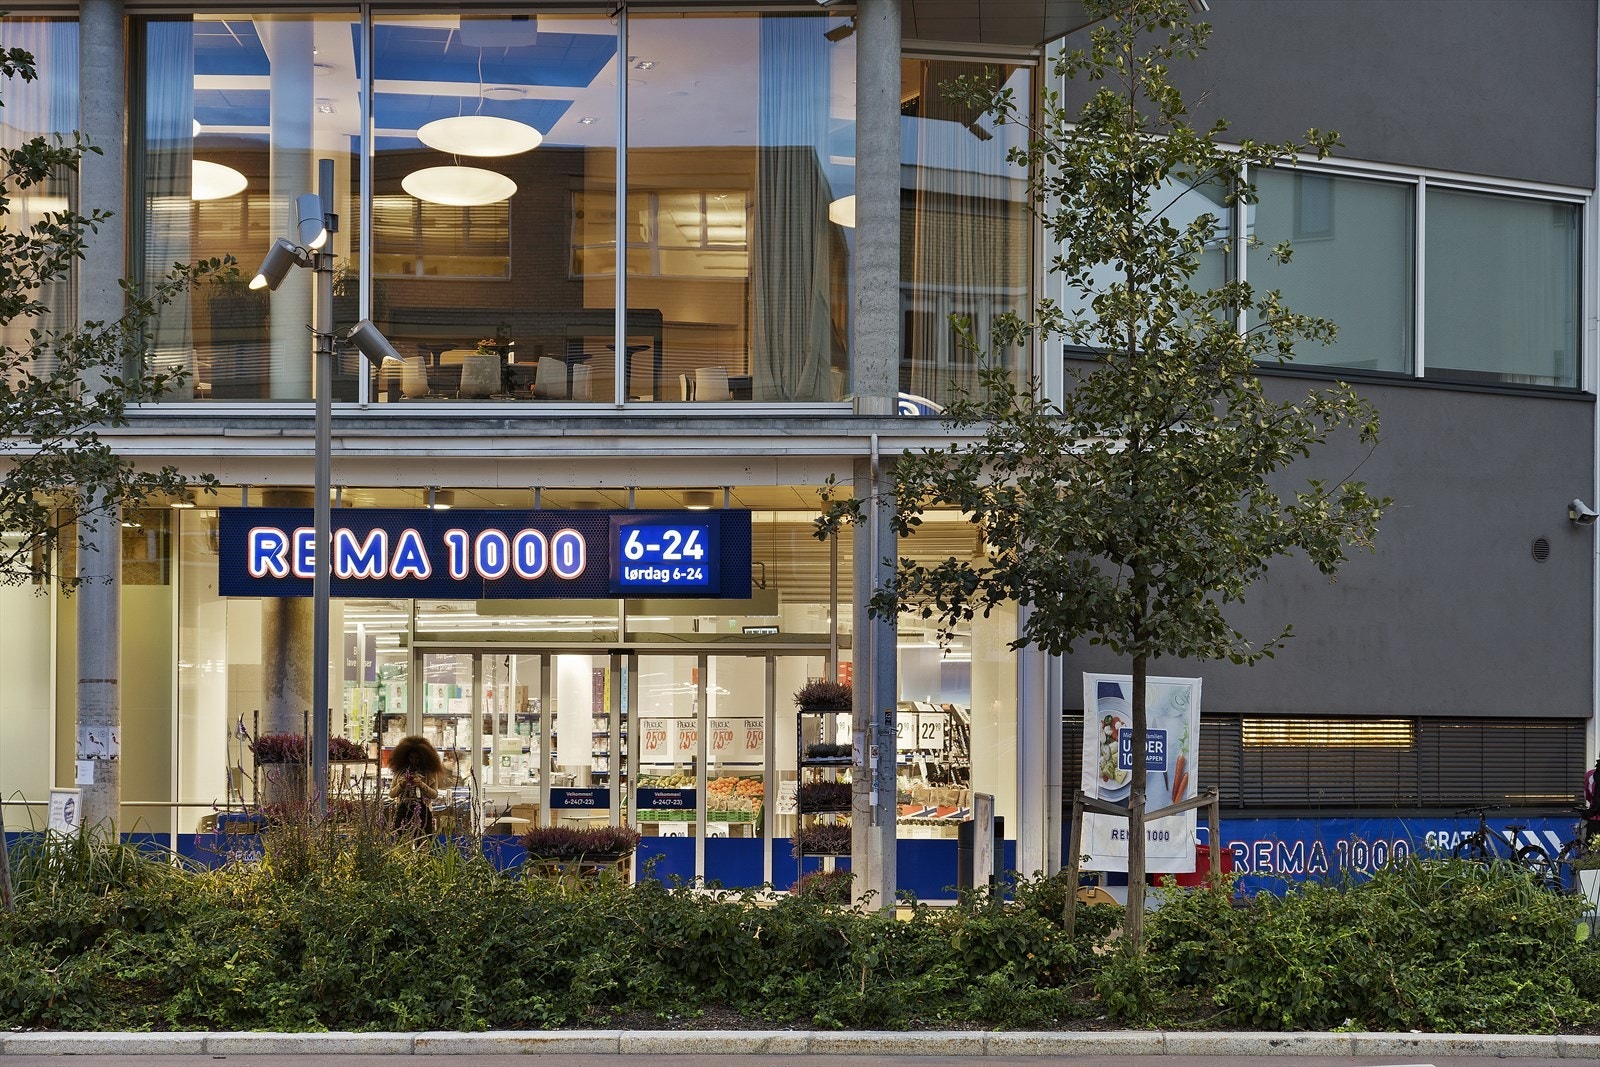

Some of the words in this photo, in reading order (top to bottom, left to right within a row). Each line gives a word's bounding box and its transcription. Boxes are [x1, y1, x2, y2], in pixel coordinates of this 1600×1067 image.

[248, 527, 432, 580] REMA
[444, 528, 587, 580] 1000
[624, 529, 704, 561] 6-24
[625, 566, 670, 583] lørdag
[673, 567, 704, 580] 6-24
[1147, 829, 1170, 841] 1000
[1229, 840, 1328, 873] REMA
[1336, 840, 1409, 873] 1000
